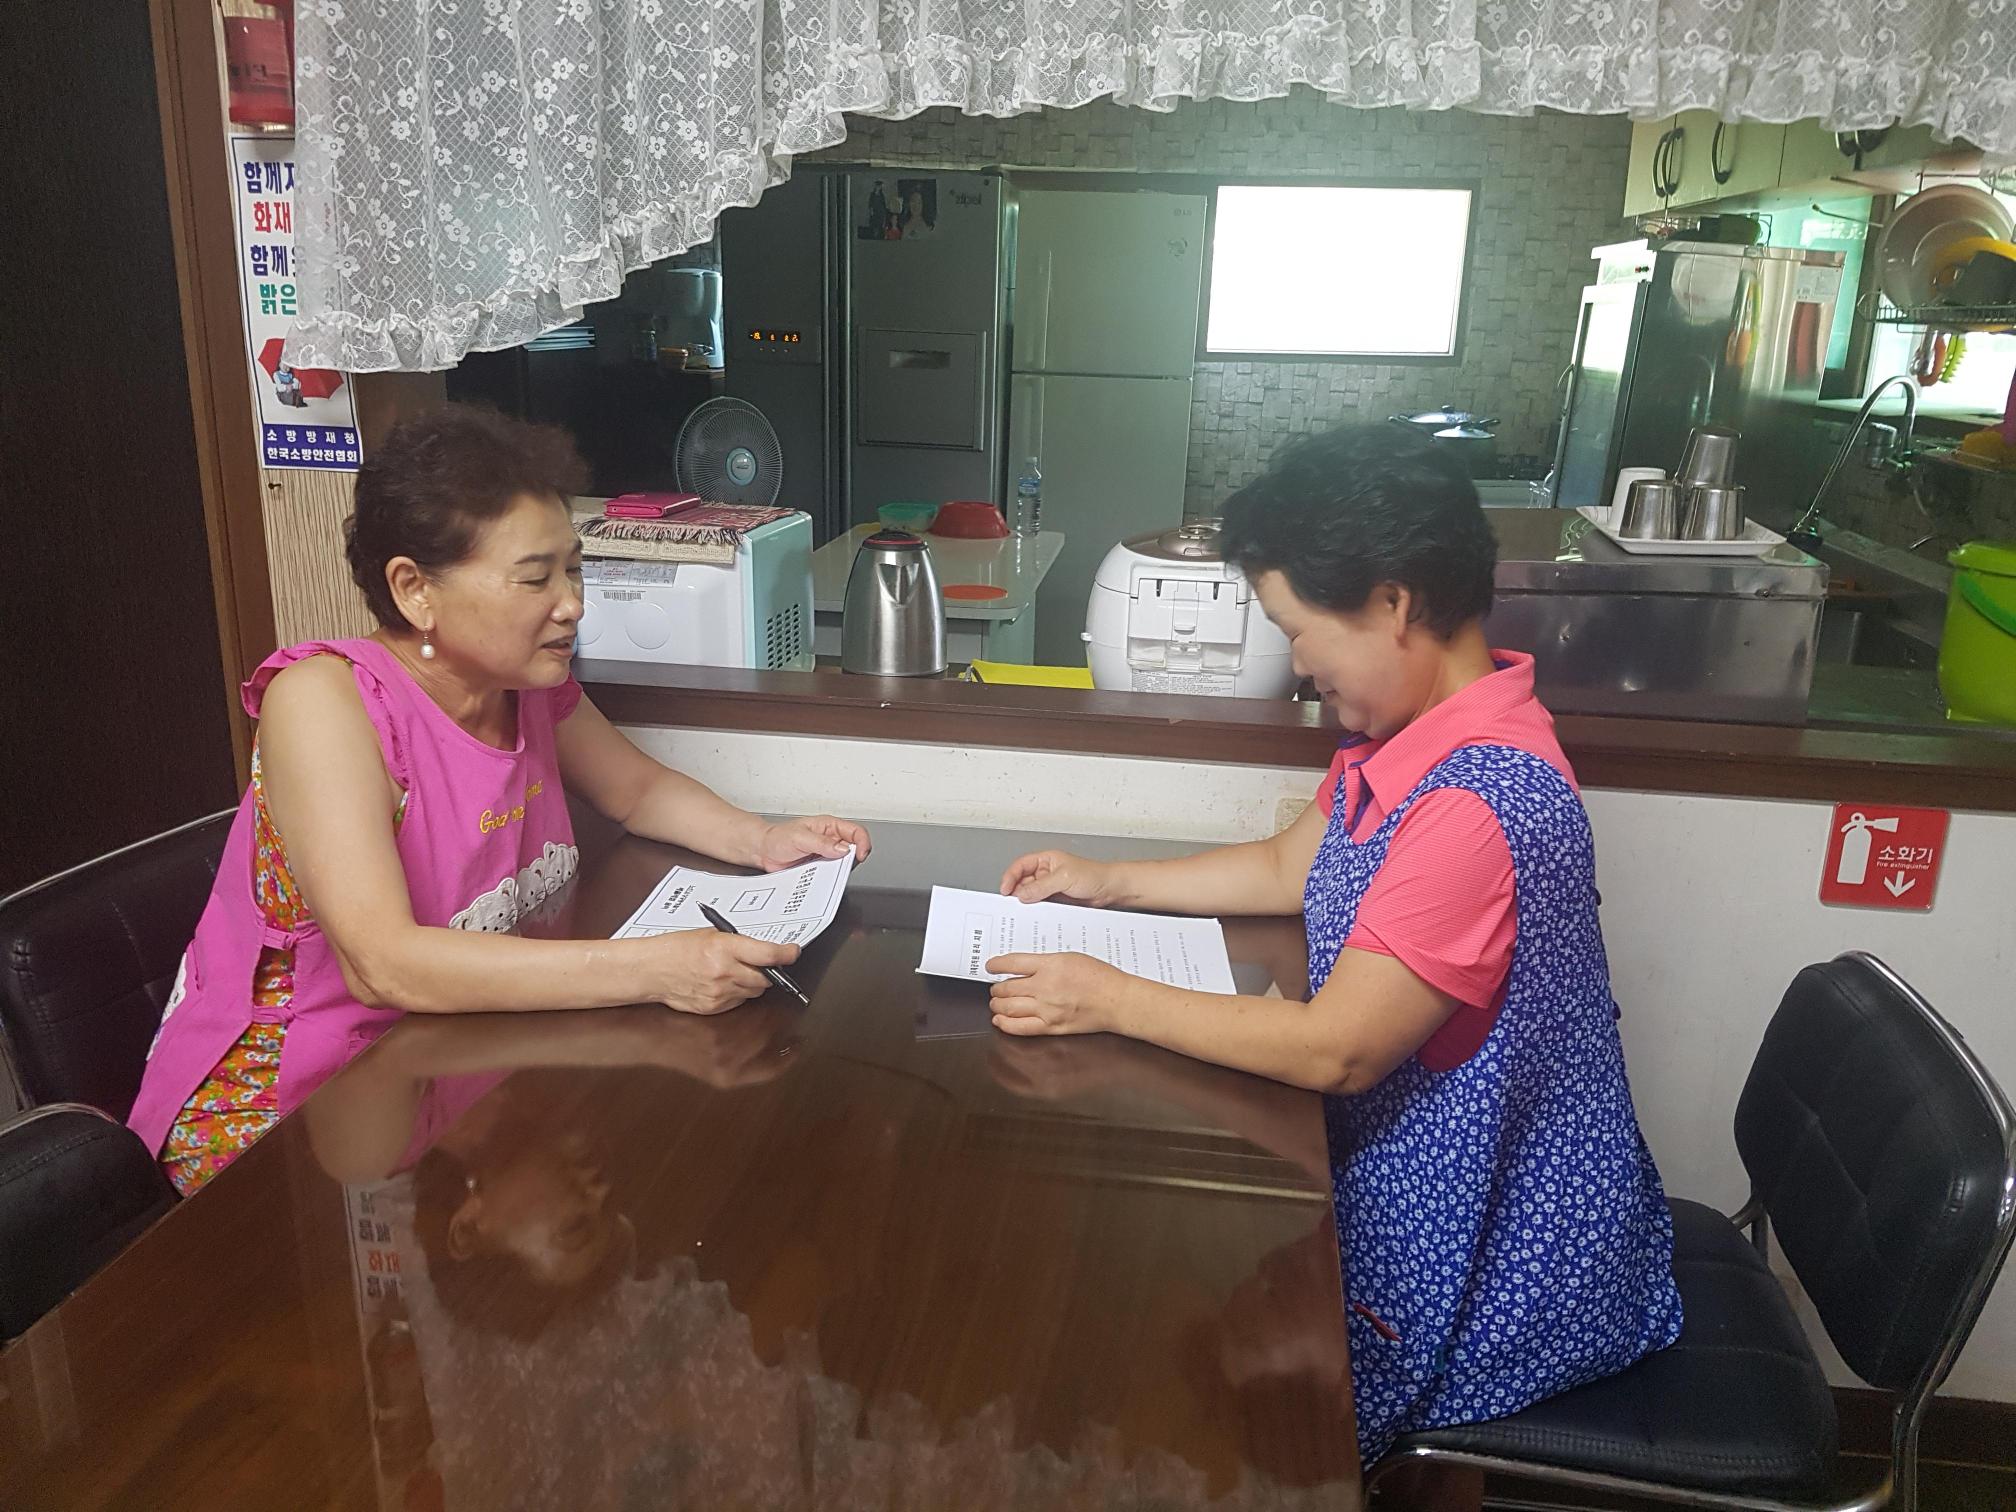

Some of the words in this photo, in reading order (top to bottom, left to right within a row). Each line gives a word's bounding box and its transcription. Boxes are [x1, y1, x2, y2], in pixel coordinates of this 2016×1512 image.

[250, 244, 296, 277] 함께
[267, 447, 358, 462] 한국소방안전협회
[1878, 845, 1933, 864] 소화기
